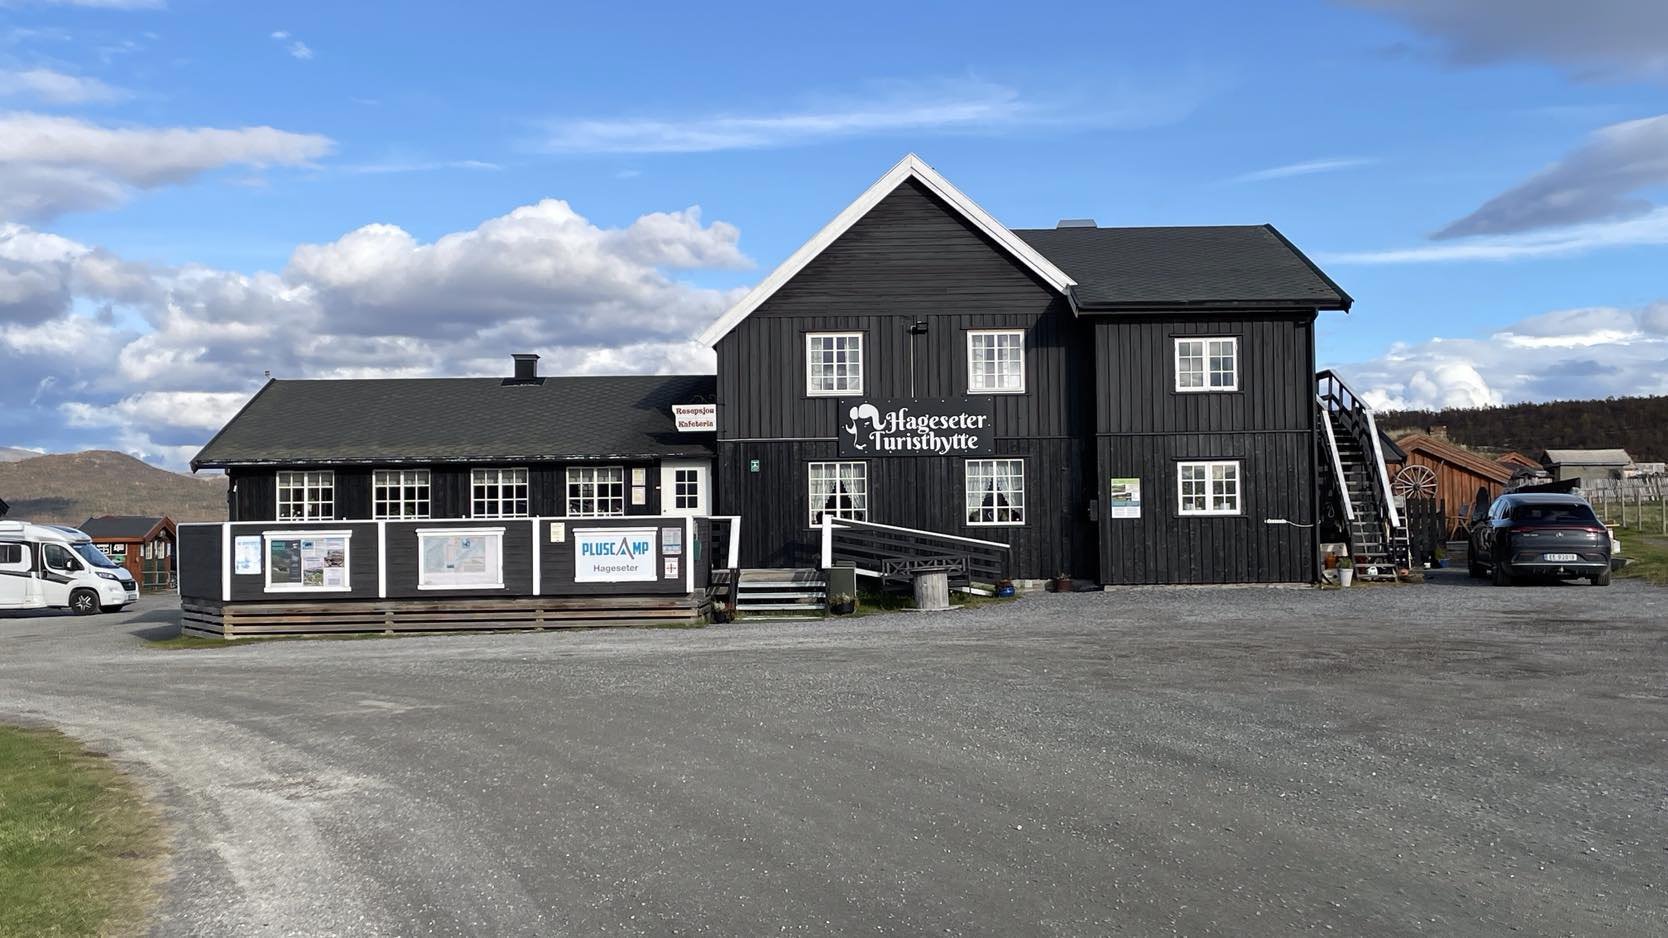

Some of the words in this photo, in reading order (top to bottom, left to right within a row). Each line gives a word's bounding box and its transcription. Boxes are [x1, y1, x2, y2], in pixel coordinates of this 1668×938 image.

[886, 408, 986, 433] Hageseter
[869, 431, 978, 454] Turisthytte
[582, 537, 649, 559] PLUSCAMP
[593, 564, 638, 573] Hageseter
